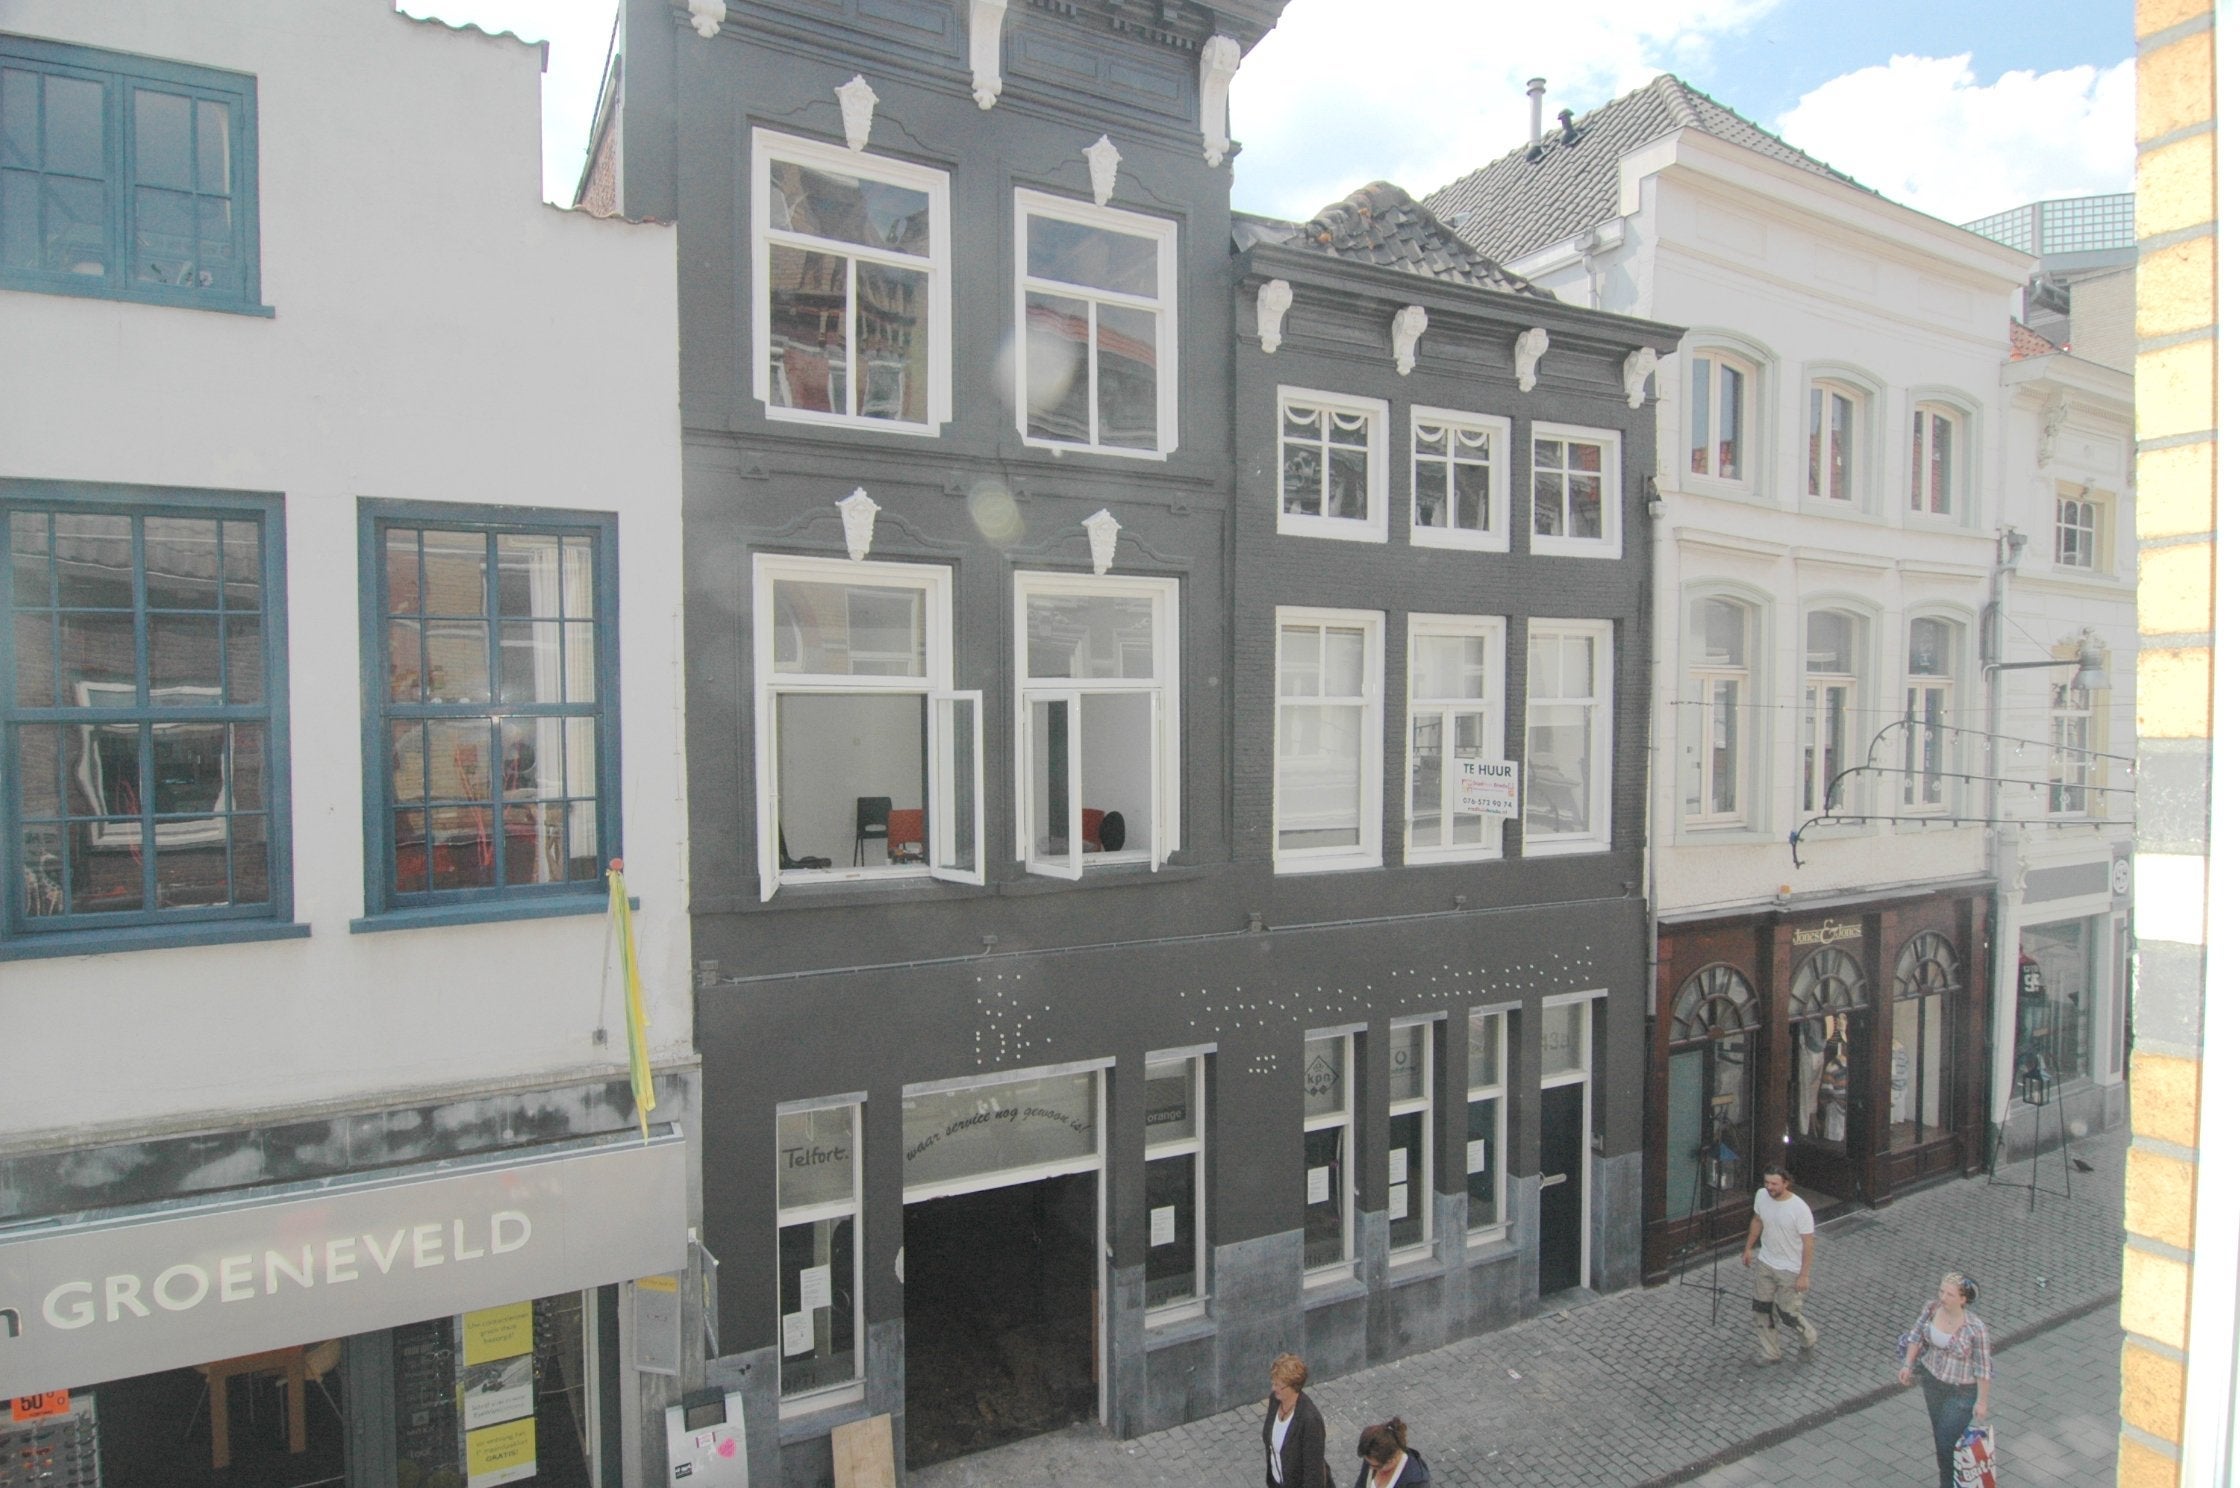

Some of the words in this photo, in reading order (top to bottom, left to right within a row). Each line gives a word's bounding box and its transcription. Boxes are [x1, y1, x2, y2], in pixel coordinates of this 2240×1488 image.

[1464, 763, 1474, 774] TE
[1478, 764, 1511, 777] HUUR
[1793, 929, 1821, 945] Jones
[1835, 924, 1863, 940] Jones
[1307, 1072, 1331, 1085] kpn
[1147, 1110, 1182, 1123] orange
[906, 1132, 941, 1161] waar
[945, 1111, 991, 1136] service
[995, 1107, 1019, 1122] nog
[1023, 1107, 1069, 1123] gewoon
[1070, 1118, 1092, 1134] is!
[42, 1210, 533, 1330] GROENEVELD
